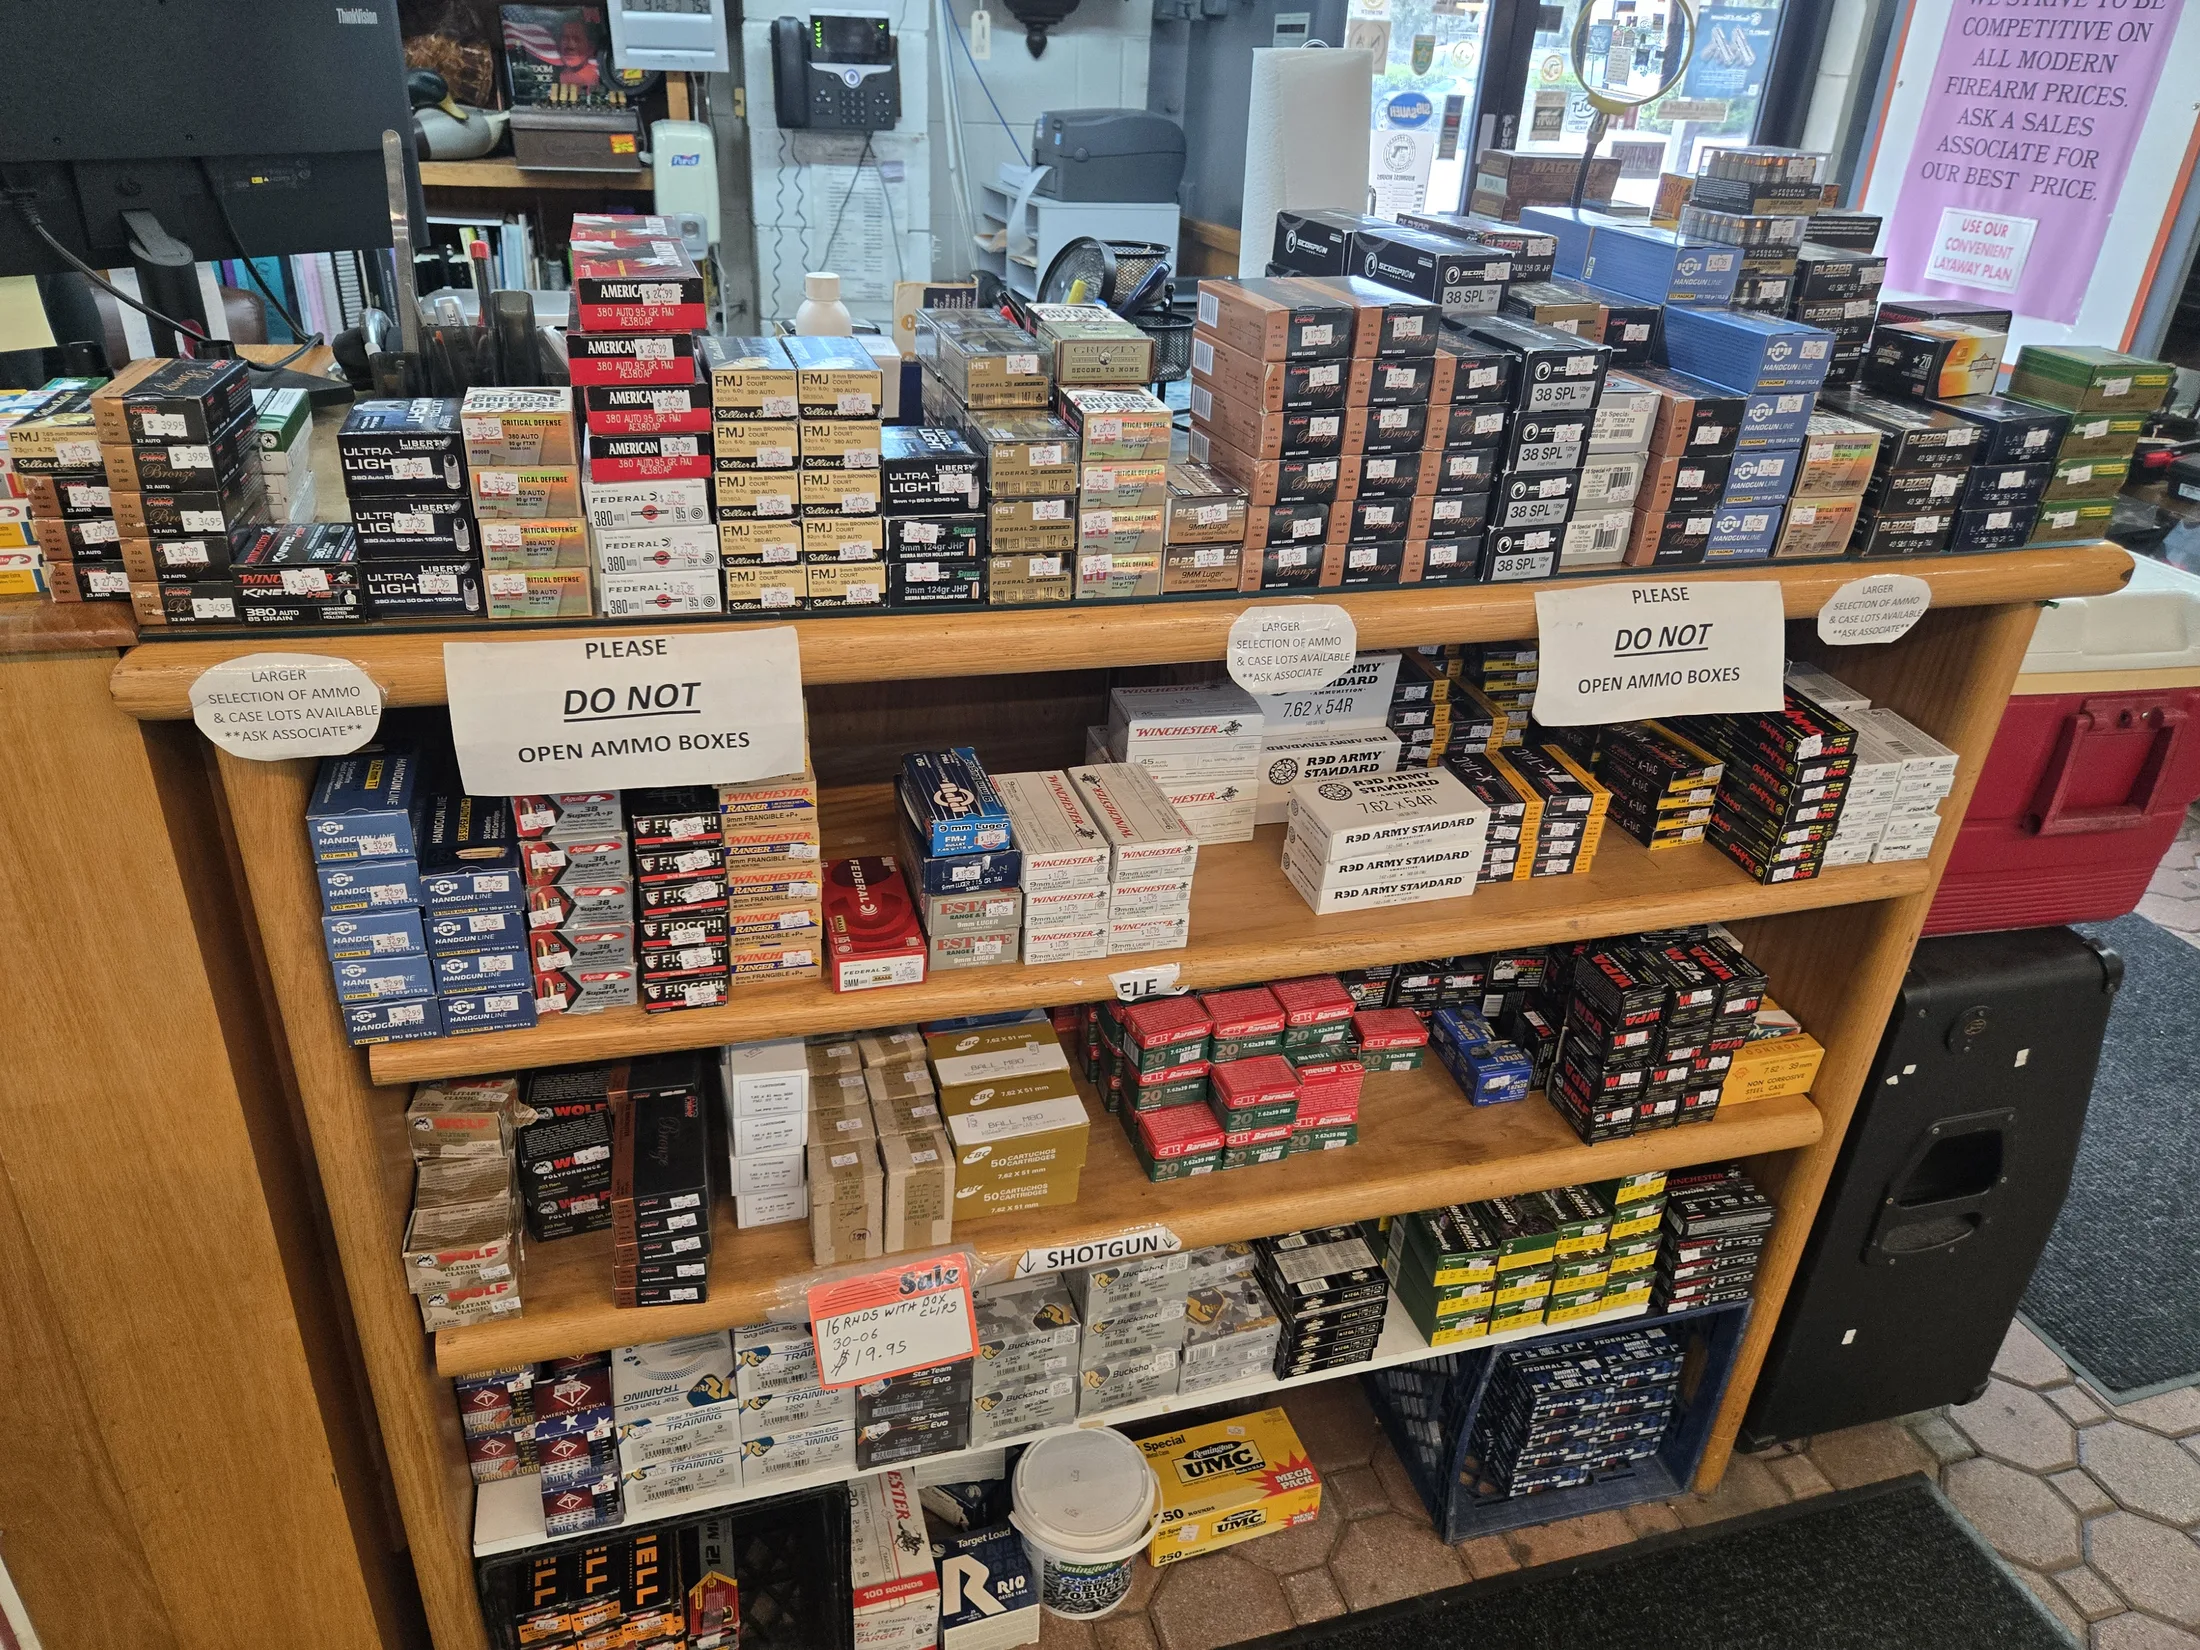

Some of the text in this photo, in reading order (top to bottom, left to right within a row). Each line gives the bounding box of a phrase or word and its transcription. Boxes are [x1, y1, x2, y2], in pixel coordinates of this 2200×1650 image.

[336, 8, 377, 24] ThinkVision
[1963, 17, 2153, 42] COMPETITIVE ON
[1972, 48, 2118, 73] ALL MODERN
[1945, 76, 2128, 107] FIREARM PRICES.
[1957, 108, 2095, 136] ASK A SALES
[1936, 135, 2100, 169] ASSOCIATE FOR
[1921, 161, 2097, 201] OUR BEST PRICE.
[1962, 218, 2009, 238] USE OUR
[1945, 237, 2015, 260] CONVENIENT
[1378, 262, 1416, 280] SCORPION
[1934, 255, 2013, 281] LAYAWAY PLAN
[1674, 278, 1722, 286] HANDGUN LINE
[1445, 288, 1485, 303] 38 SPL
[597, 307, 613, 317] 380
[616, 307, 633, 317] AUTO
[635, 307, 646, 317] 95
[662, 307, 674, 316] FMJ
[620, 316, 654, 326] AE380AP
[715, 375, 742, 387] FMJ
[502, 419, 562, 427] CRITICAL DEFENSE
[399, 439, 446, 447] LIBERTY
[608, 441, 658, 455] AMERICAN
[142, 465, 196, 483] Bronze
[592, 495, 647, 505] FEDERAL
[1188, 522, 1230, 532] 9MM Luger
[900, 541, 965, 553] 9mm 124gr JHP
[1632, 587, 1690, 604] PLEASE
[1862, 584, 1894, 595] LARGER
[1833, 596, 1920, 611] SELECTION OF AMMO
[246, 608, 276, 617] 380
[1828, 609, 1923, 624] & CASE LOTS AVAILABLE
[1262, 621, 1301, 633] LARGER
[1236, 636, 1342, 649] SELECTION OF AMMO
[1614, 623, 1714, 651] DO NOT
[585, 638, 668, 660] PLEASE
[1236, 652, 1351, 666] & CASE LOTS AVAILABLE
[251, 669, 308, 683] LARGER
[1274, 667, 1324, 681] ASSOCIATE
[1578, 667, 1740, 694] OPEN AMMO BOXES
[208, 686, 361, 705] SELECTION OF AMMO
[563, 682, 702, 715] DO NOT
[213, 704, 379, 724] & CASE LOTS AVAILABLE
[1135, 724, 1218, 738] WINCHESTER
[518, 732, 750, 763] OPEN AMMO BOXES
[1338, 751, 1382, 764] ARMY
[725, 787, 812, 802] WINCHESTER
[726, 803, 768, 813] RANGER
[1357, 799, 1394, 815] 7.62
[1402, 794, 1438, 808] 54R
[727, 815, 744, 824] 9mm
[745, 813, 784, 823] FRANGIBLE
[950, 824, 972, 832] mm
[974, 822, 1009, 832] Luger
[1121, 846, 1182, 860] WINCHESTER
[432, 893, 493, 904] HANDGUN LINE
[1747, 1072, 1805, 1088] NON CORROSIVE
[973, 1091, 993, 1101] CBC
[1745, 1083, 1785, 1094] STEEL CASE
[553, 1103, 607, 1117] WOLF
[991, 1148, 1056, 1168] 50 CARTUCHOS
[1007, 1154, 1056, 1167] CARTRIDGES
[543, 1164, 601, 1180] POLYFORMANCE
[1047, 1235, 1158, 1268] SHOTGUN
[899, 1265, 959, 1295] Sale
[826, 1294, 946, 1337] 16 RNDS WITH BOX
[920, 1301, 957, 1317] CLIPS
[833, 1328, 878, 1350] 30-06
[1523, 1363, 1562, 1373] FEDERAL
[1006, 1387, 1049, 1402] Buckshot
[540, 1402, 606, 1420] AMERICAN TACTICAL
[666, 1413, 684, 1422] Star
[685, 1410, 705, 1418] Team
[471, 1415, 534, 1434] TARGET LOAD
[666, 1413, 722, 1431] TRAINING
[1143, 1434, 1186, 1453] Special
[1193, 1442, 1235, 1459] Remington
[1182, 1448, 1253, 1477] UMC
[1275, 1467, 1313, 1483] MEGA
[1280, 1475, 1315, 1490] PACK
[1188, 1505, 1215, 1516] ROUNDS
[957, 1527, 1011, 1549] Target Load
[862, 1579, 923, 1600] 100 ROUNDS
[997, 1575, 1026, 1595] RIO
